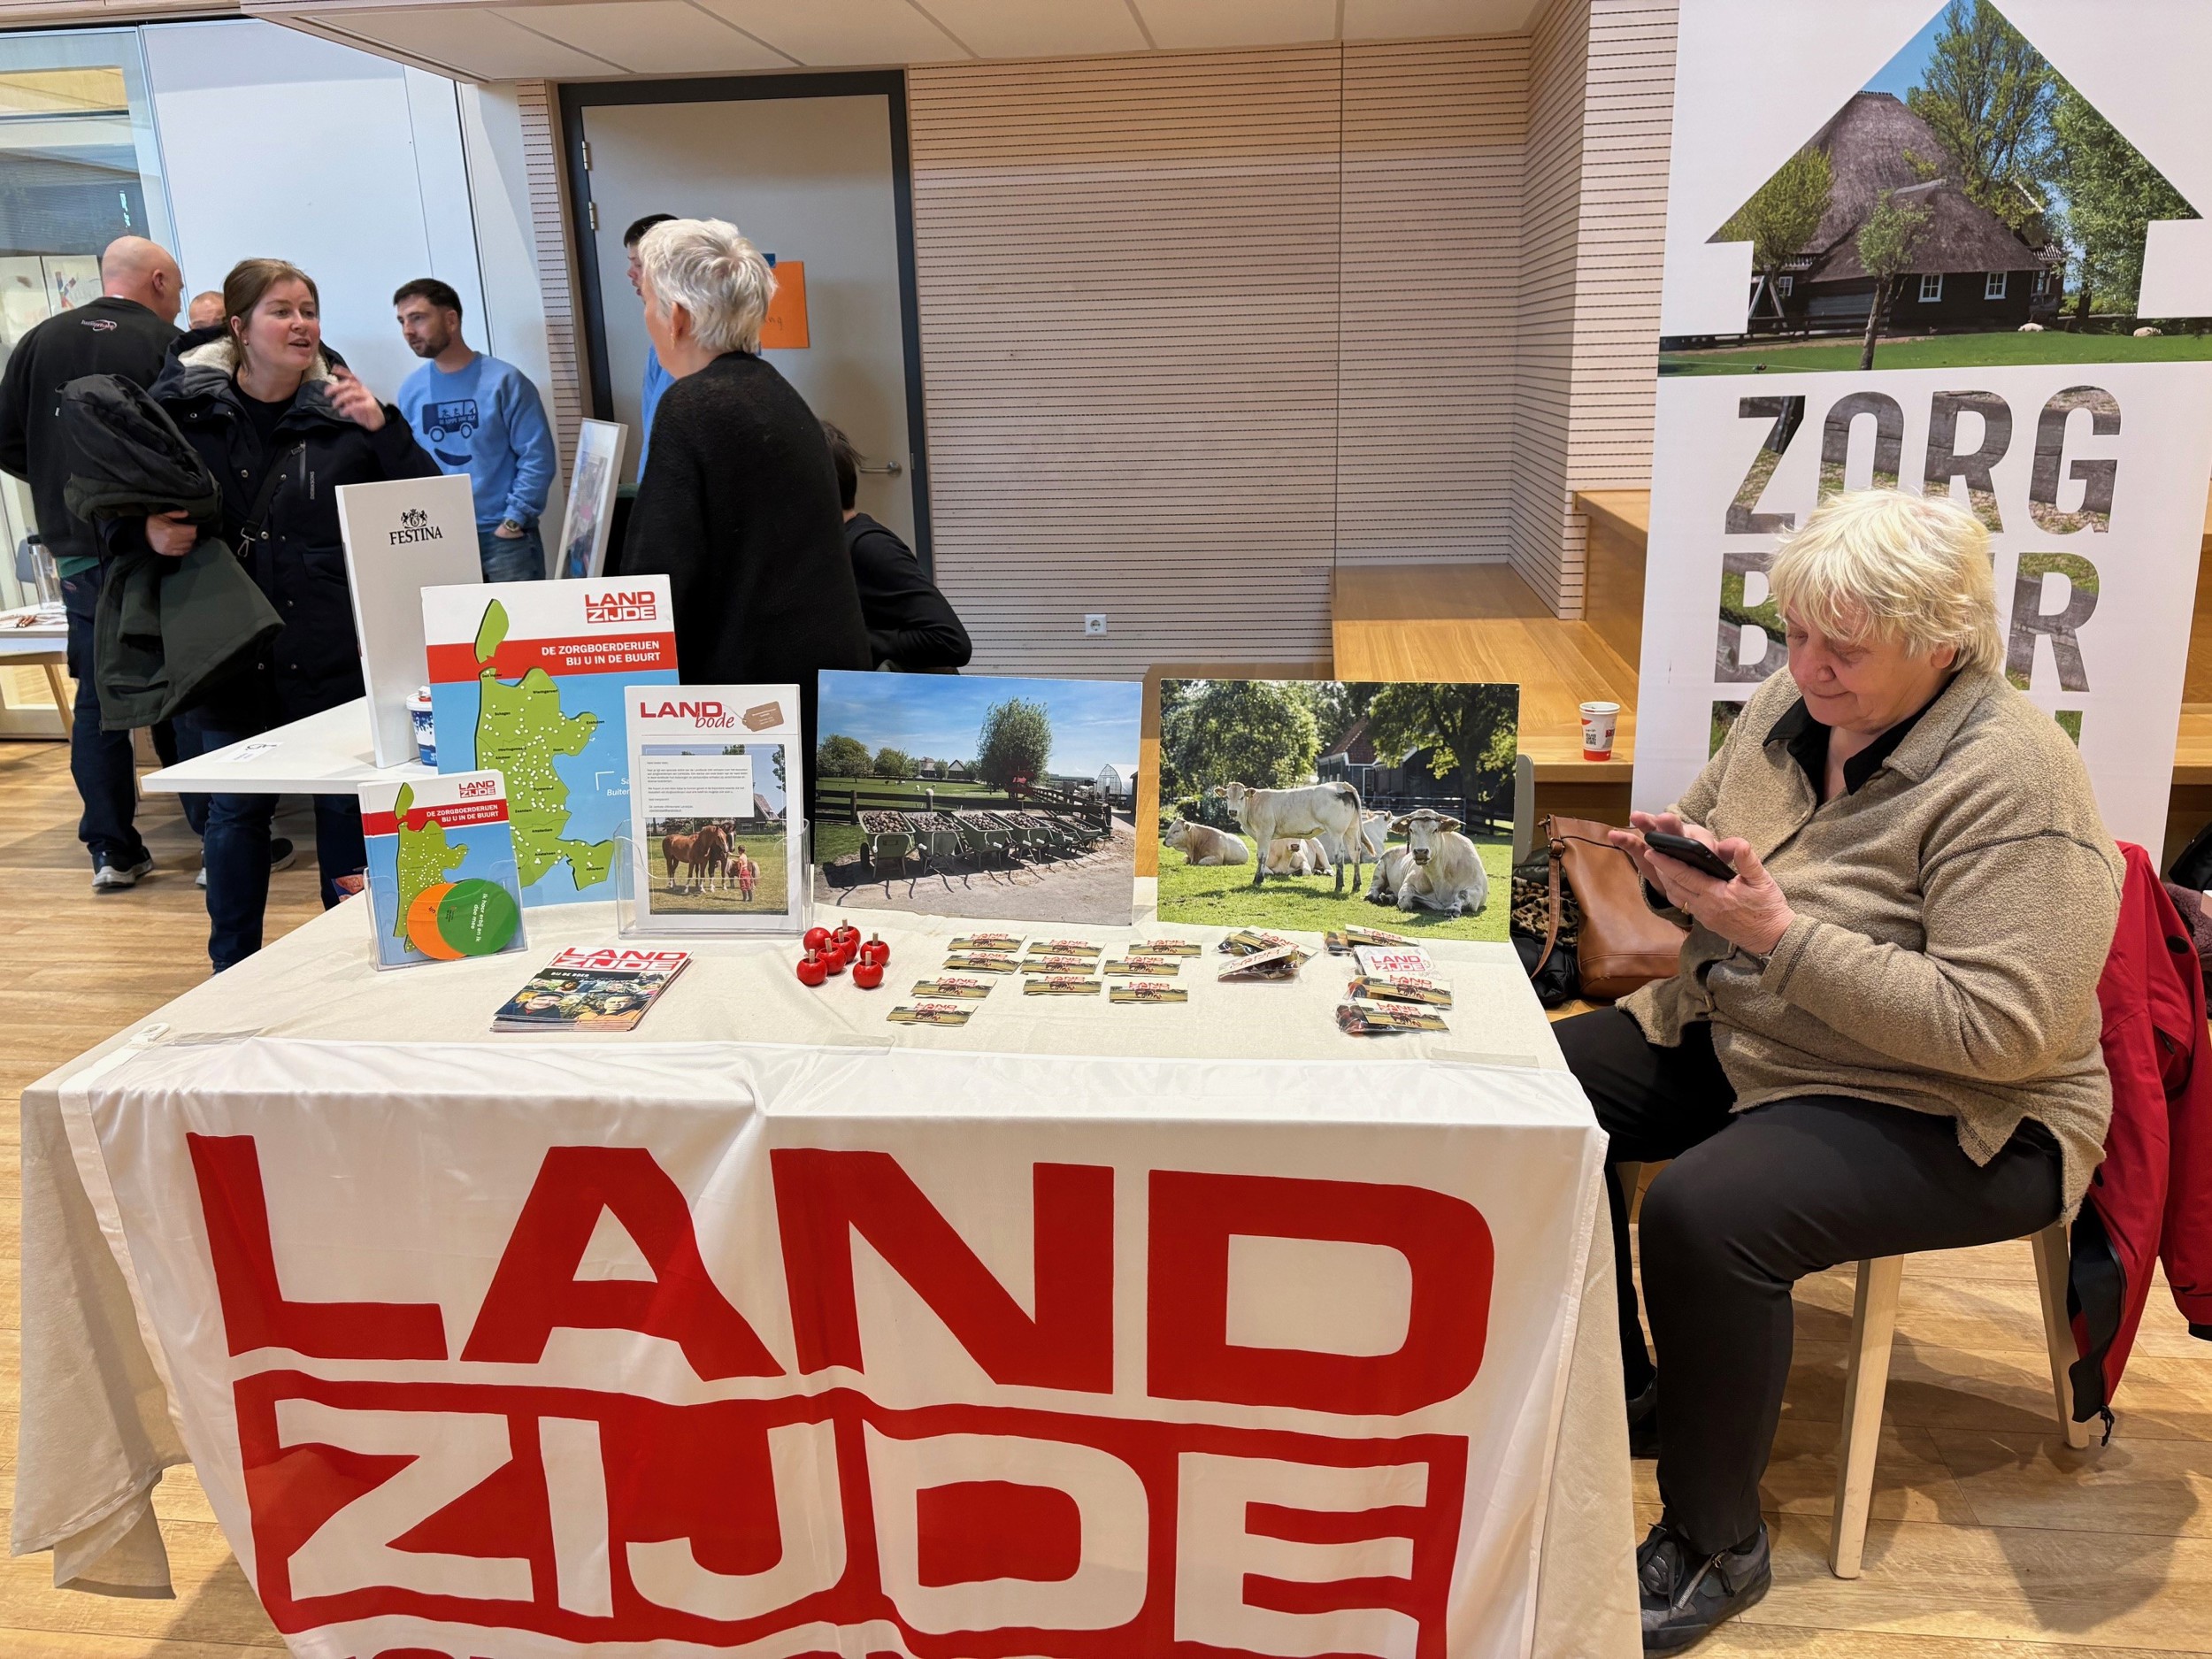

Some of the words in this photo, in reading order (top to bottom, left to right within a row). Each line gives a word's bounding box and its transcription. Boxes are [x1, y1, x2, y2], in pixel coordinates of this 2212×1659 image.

[1725, 385, 2122, 535] ZORG
[389, 526, 443, 545] FESTINA
[585, 591, 656, 607] LAND
[588, 606, 656, 622] ZIJDE
[1714, 551, 2101, 693] BR
[541, 647, 557, 656] DE
[558, 641, 659, 655] ZORGBOERDERIJEN
[566, 657, 581, 666] BIJ
[584, 656, 592, 664] U
[595, 655, 605, 664] IN
[608, 654, 622, 664] DE
[625, 652, 661, 663] BUURT
[640, 702, 723, 718] LAND
[695, 711, 734, 728] bode
[458, 780, 495, 790] LAND
[461, 787, 495, 798] ZIJDE
[437, 804, 498, 817] ZORGBOERDERIJEN
[563, 947, 688, 961] LAND
[554, 956, 678, 971] ZIJDE
[188, 1133, 1494, 1417] LAND
[274, 1397, 1430, 1659] ZIJDE
